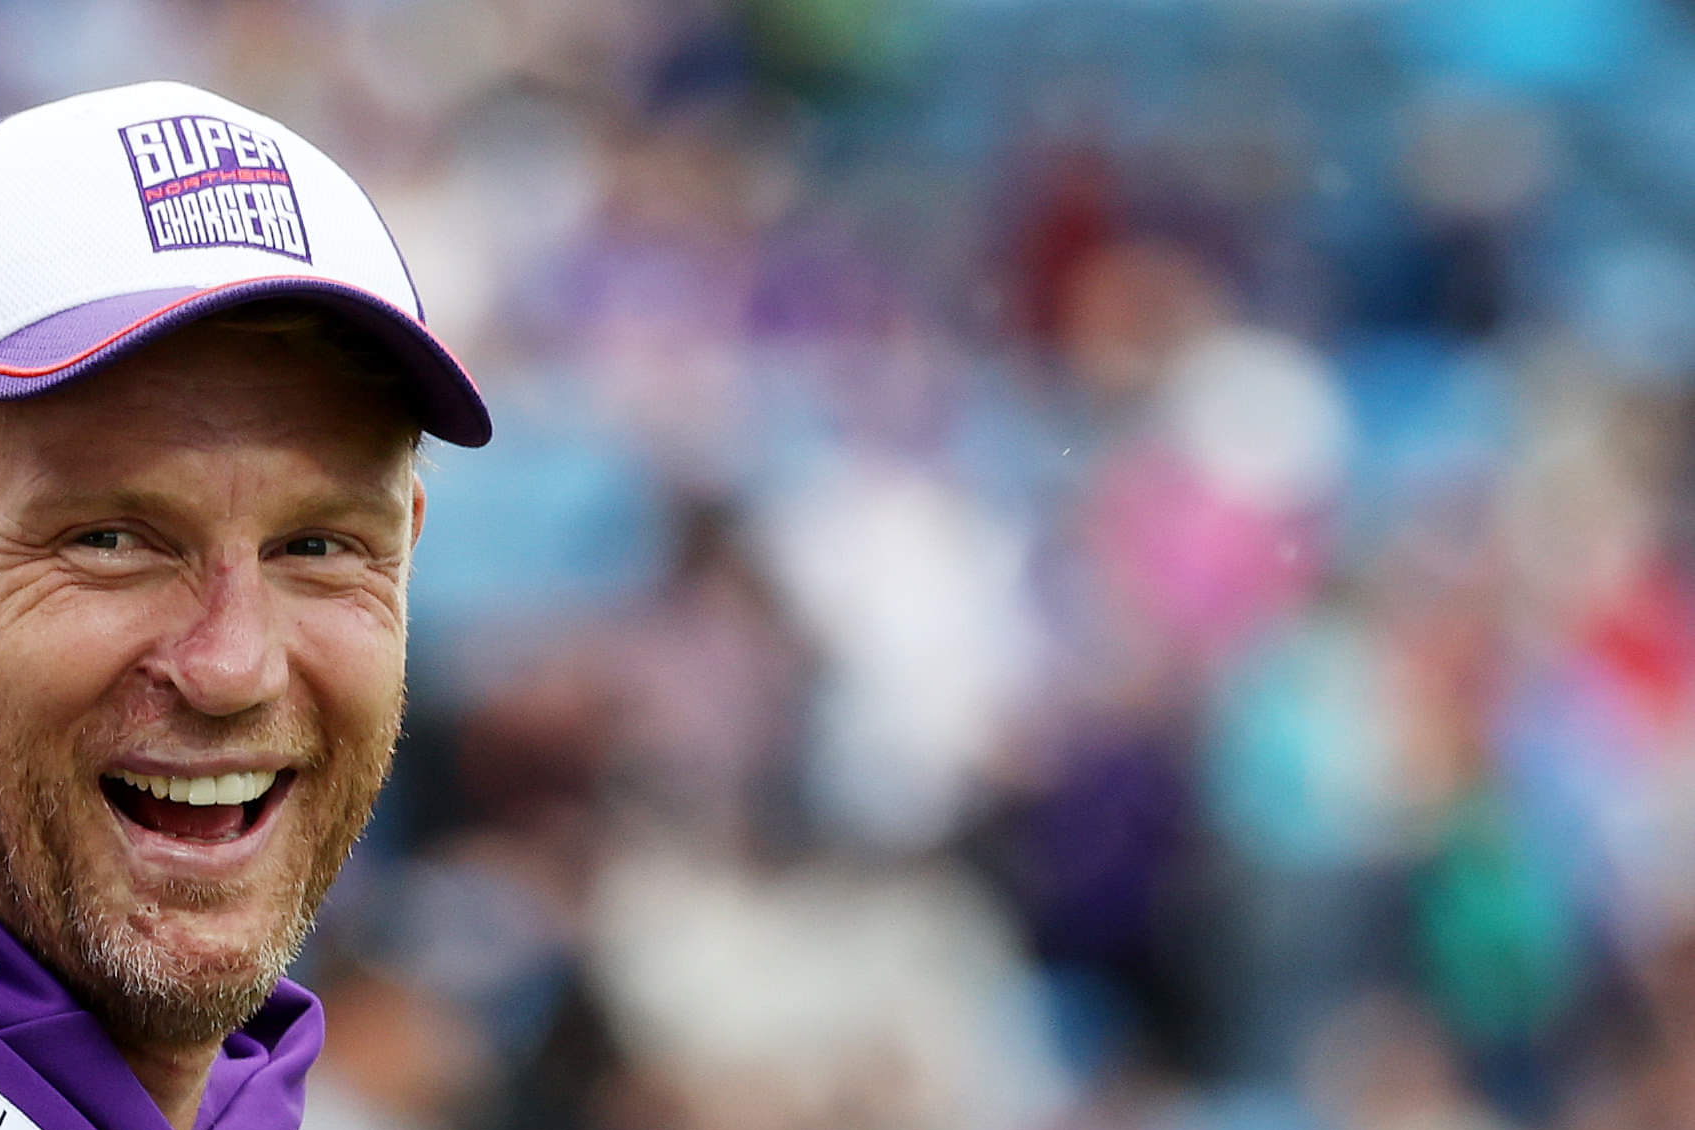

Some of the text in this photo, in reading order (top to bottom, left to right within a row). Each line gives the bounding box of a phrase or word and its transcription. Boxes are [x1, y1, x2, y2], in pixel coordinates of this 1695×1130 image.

[125, 118, 285, 188] SUPER
[144, 167, 289, 203] NORTHERN
[149, 183, 307, 258] CHARGERS
